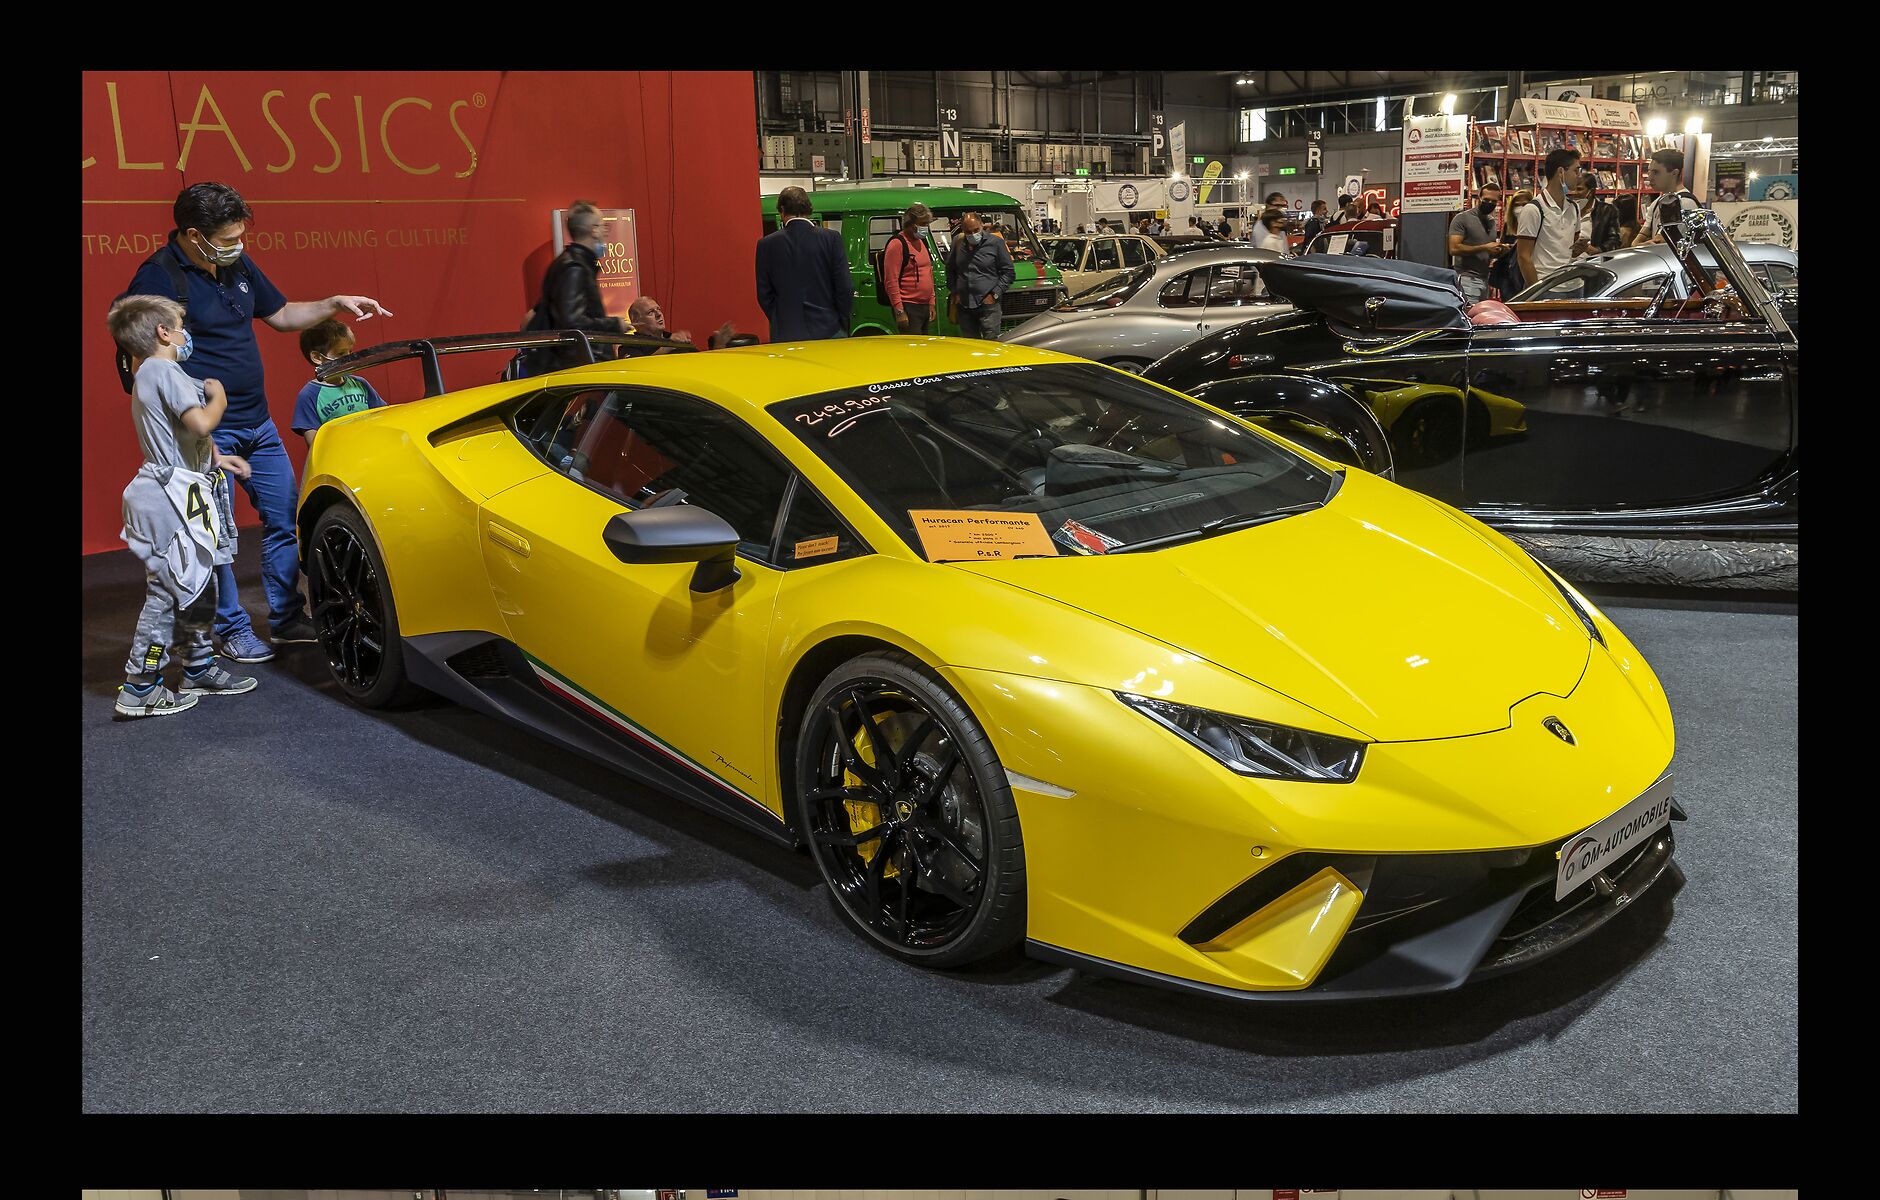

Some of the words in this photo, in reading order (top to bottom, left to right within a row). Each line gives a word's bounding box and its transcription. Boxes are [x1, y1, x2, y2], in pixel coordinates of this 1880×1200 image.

[946, 108, 957, 121] 13
[1155, 115, 1163, 125] 13
[943, 131, 960, 158] N
[1313, 130, 1321, 140] 13
[1153, 134, 1164, 157] P
[1307, 147, 1322, 168] R
[294, 229, 378, 250] DRIVING
[386, 227, 468, 248] CULTURE
[868, 380, 911, 394] Classic
[913, 375, 943, 386] Cars
[921, 517, 964, 525] Huracan
[967, 517, 1031, 526] Performante
